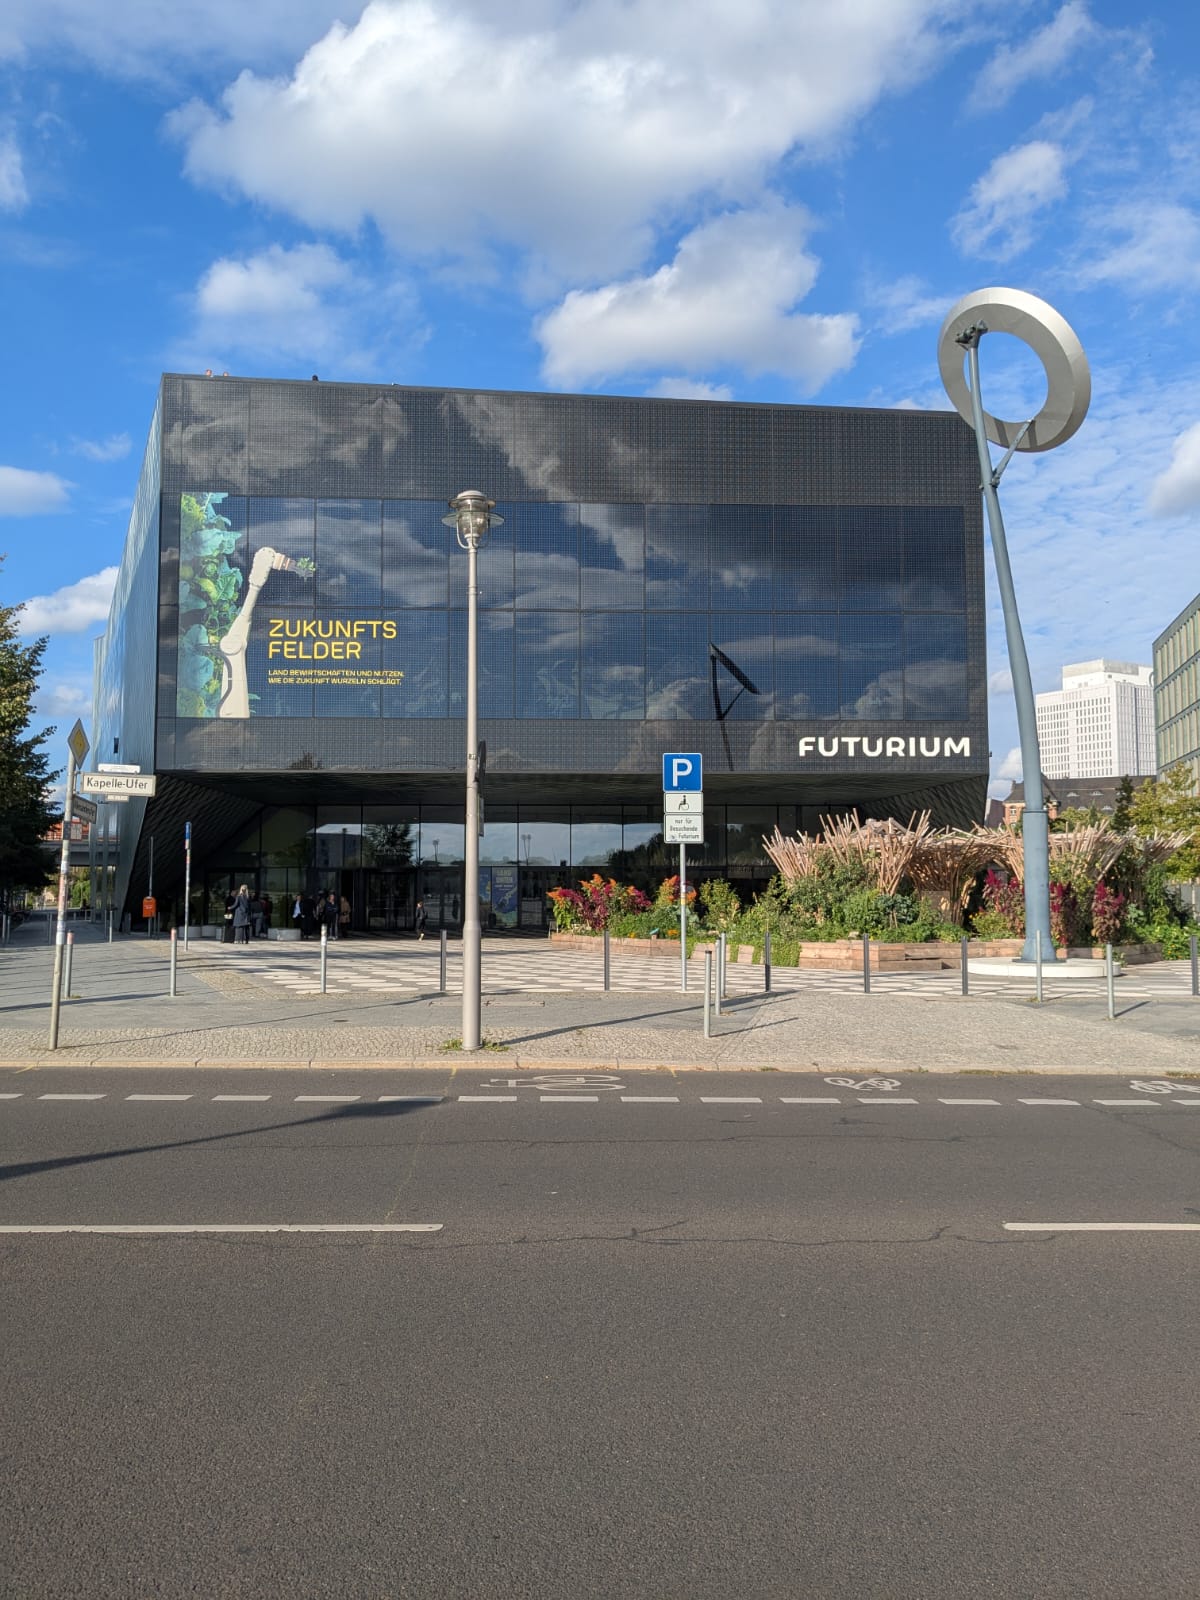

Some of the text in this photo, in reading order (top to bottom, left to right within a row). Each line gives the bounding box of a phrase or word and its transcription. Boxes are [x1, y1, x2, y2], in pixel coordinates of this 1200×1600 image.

[269, 620, 397, 639] ZUKUNFTS
[268, 641, 361, 659] FELDER
[289, 669, 356, 677] BEWIRTSCHAFTEN
[798, 736, 971, 758] FUTURIUM
[672, 758, 693, 787] P
[86, 777, 148, 790] Kapelle-Ufer
